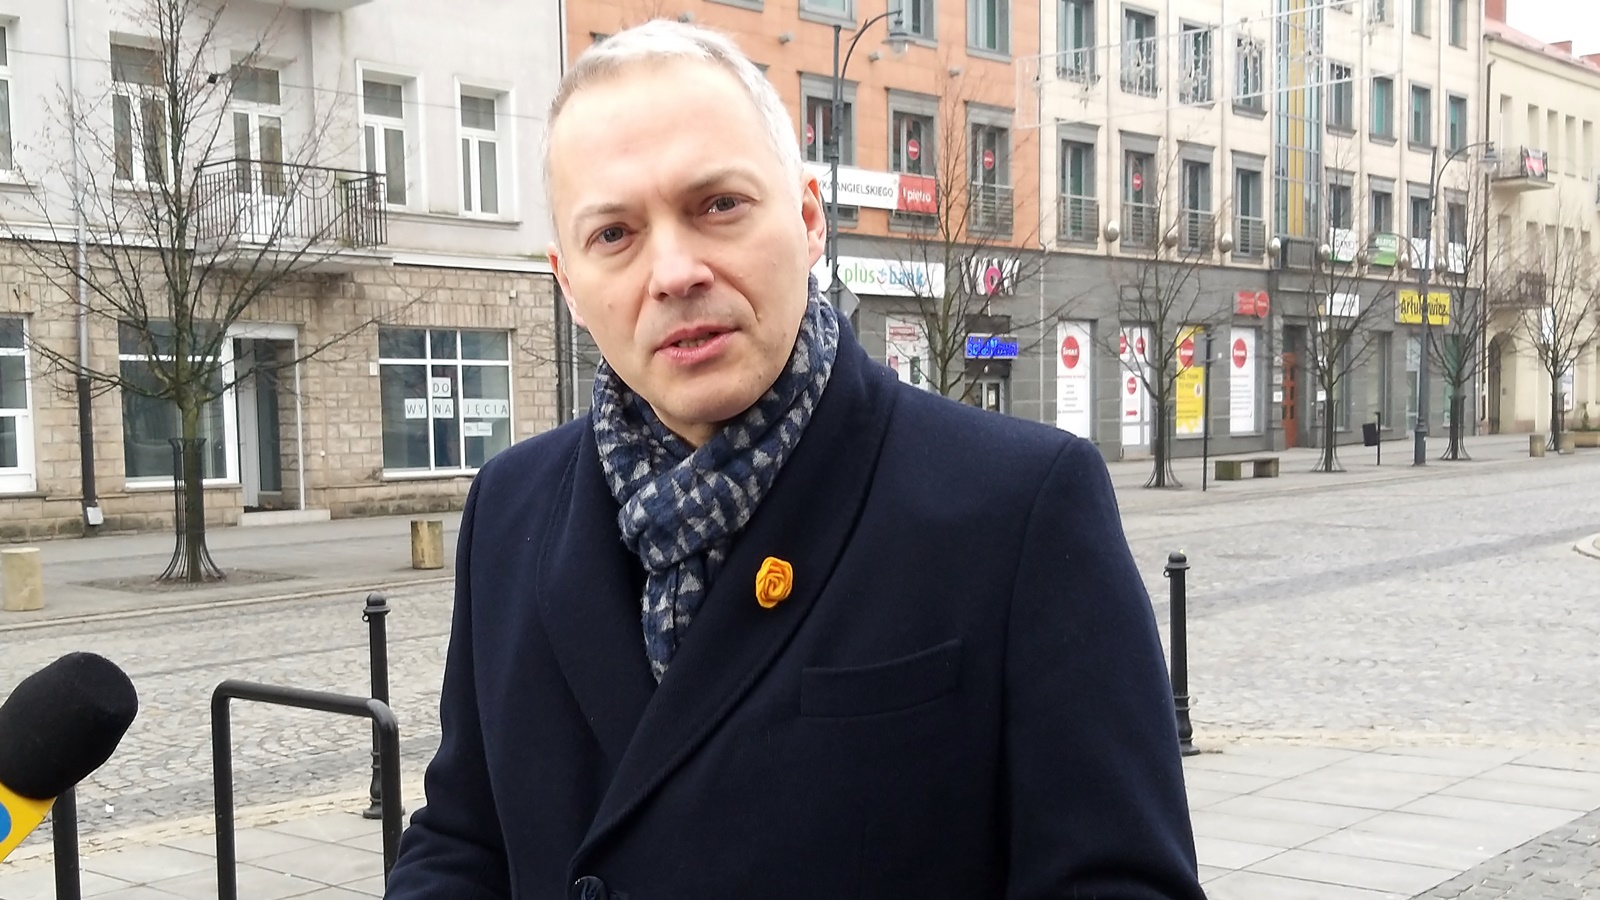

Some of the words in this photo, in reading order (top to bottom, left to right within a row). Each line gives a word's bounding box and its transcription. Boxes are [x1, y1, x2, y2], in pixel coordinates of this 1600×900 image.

[845, 266, 875, 285] plus
[889, 265, 925, 286] bank
[433, 383, 450, 393] DO
